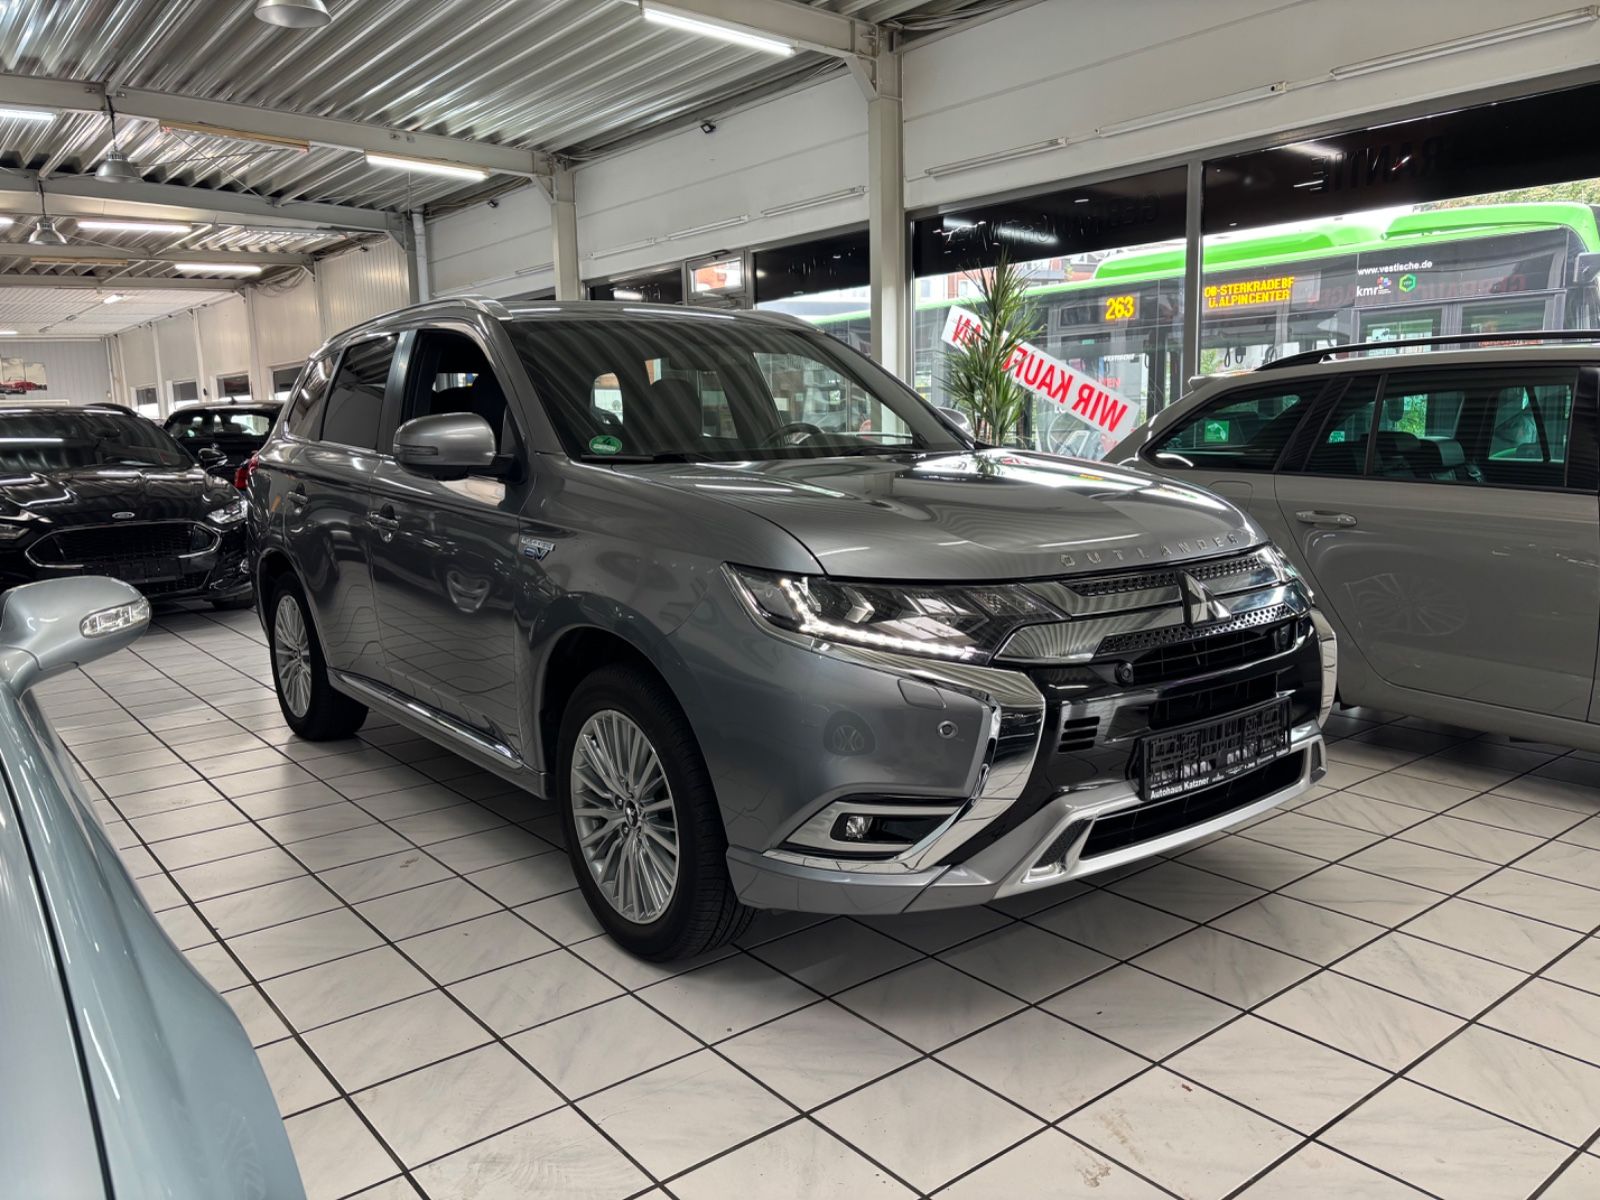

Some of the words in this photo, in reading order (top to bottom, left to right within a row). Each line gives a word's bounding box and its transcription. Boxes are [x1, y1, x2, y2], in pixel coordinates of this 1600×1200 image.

[1357, 260, 1433, 275] www.vestische.de
[1357, 286, 1379, 297] kmr
[1105, 295, 1135, 320] 263
[1060, 533, 1239, 568] OUTLANDER
[1150, 785, 1183, 800] Autohaus
[1183, 777, 1210, 791] Katzner
